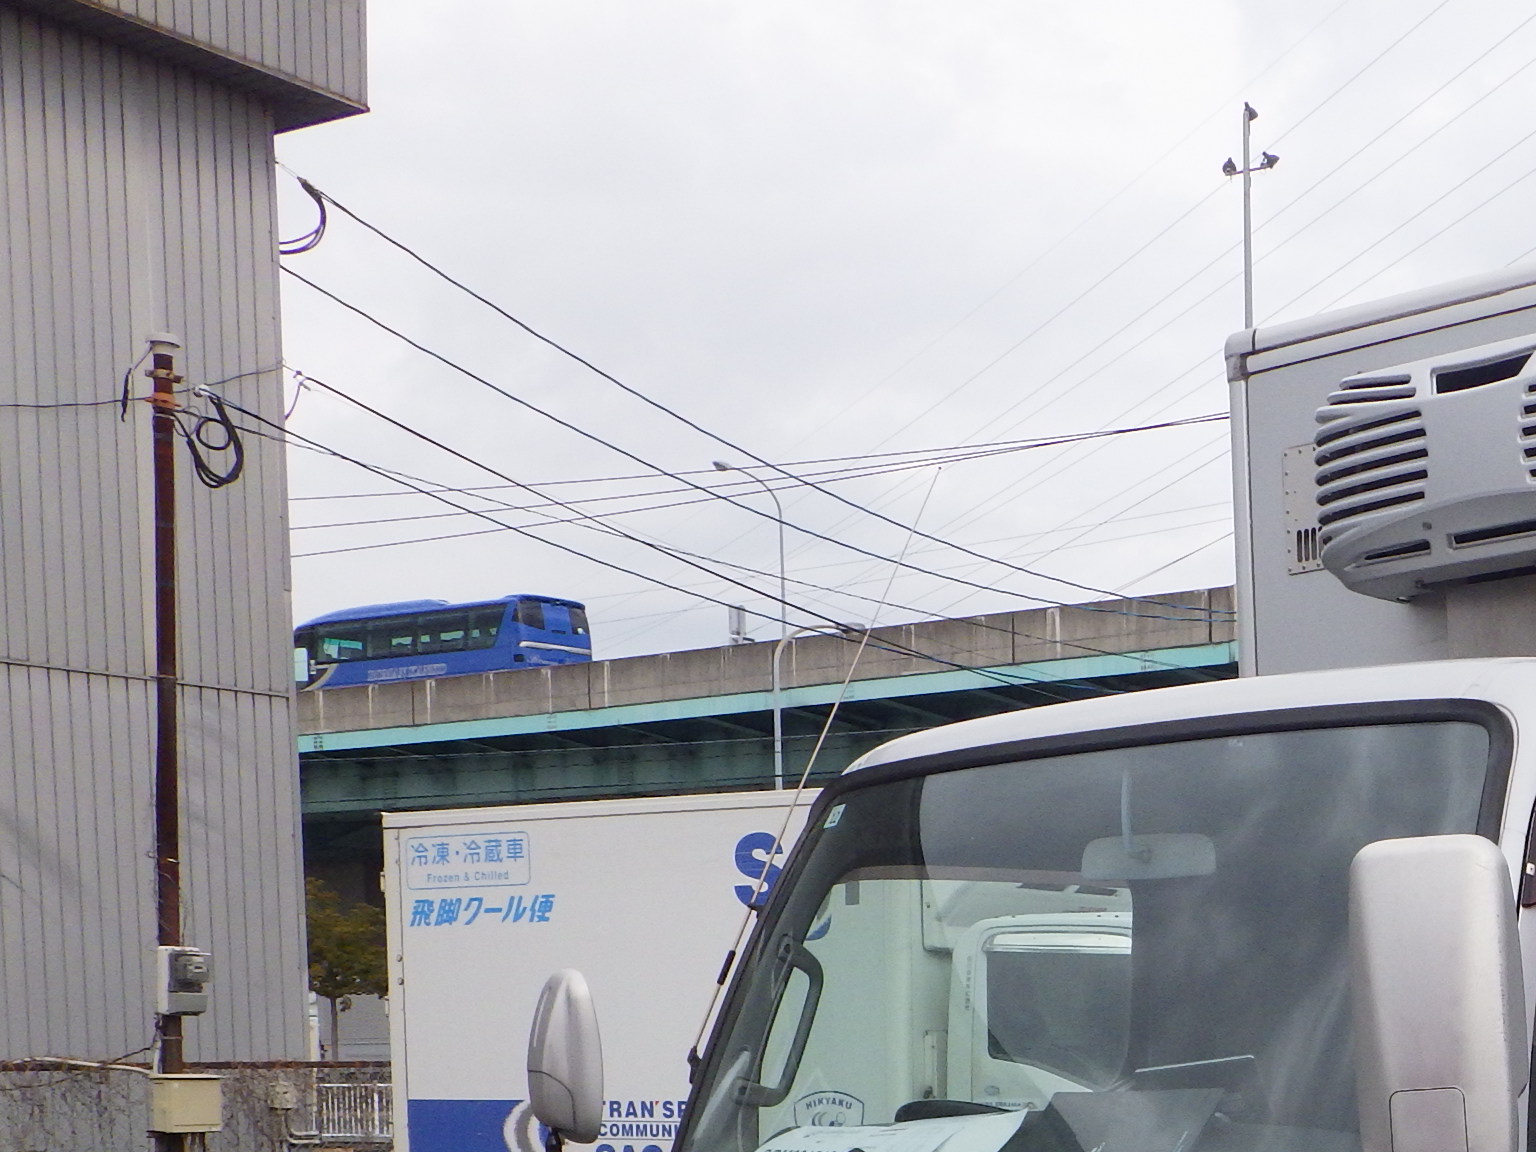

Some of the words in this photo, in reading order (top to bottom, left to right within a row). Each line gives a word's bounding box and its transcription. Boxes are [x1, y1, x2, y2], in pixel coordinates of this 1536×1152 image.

[410, 838, 525, 867] 冷凍・冷蔵車
[427, 873, 460, 884] Frozen
[463, 872, 471, 882] &
[474, 870, 510, 881] Chilled
[410, 894, 556, 927] 飛脚クール便
